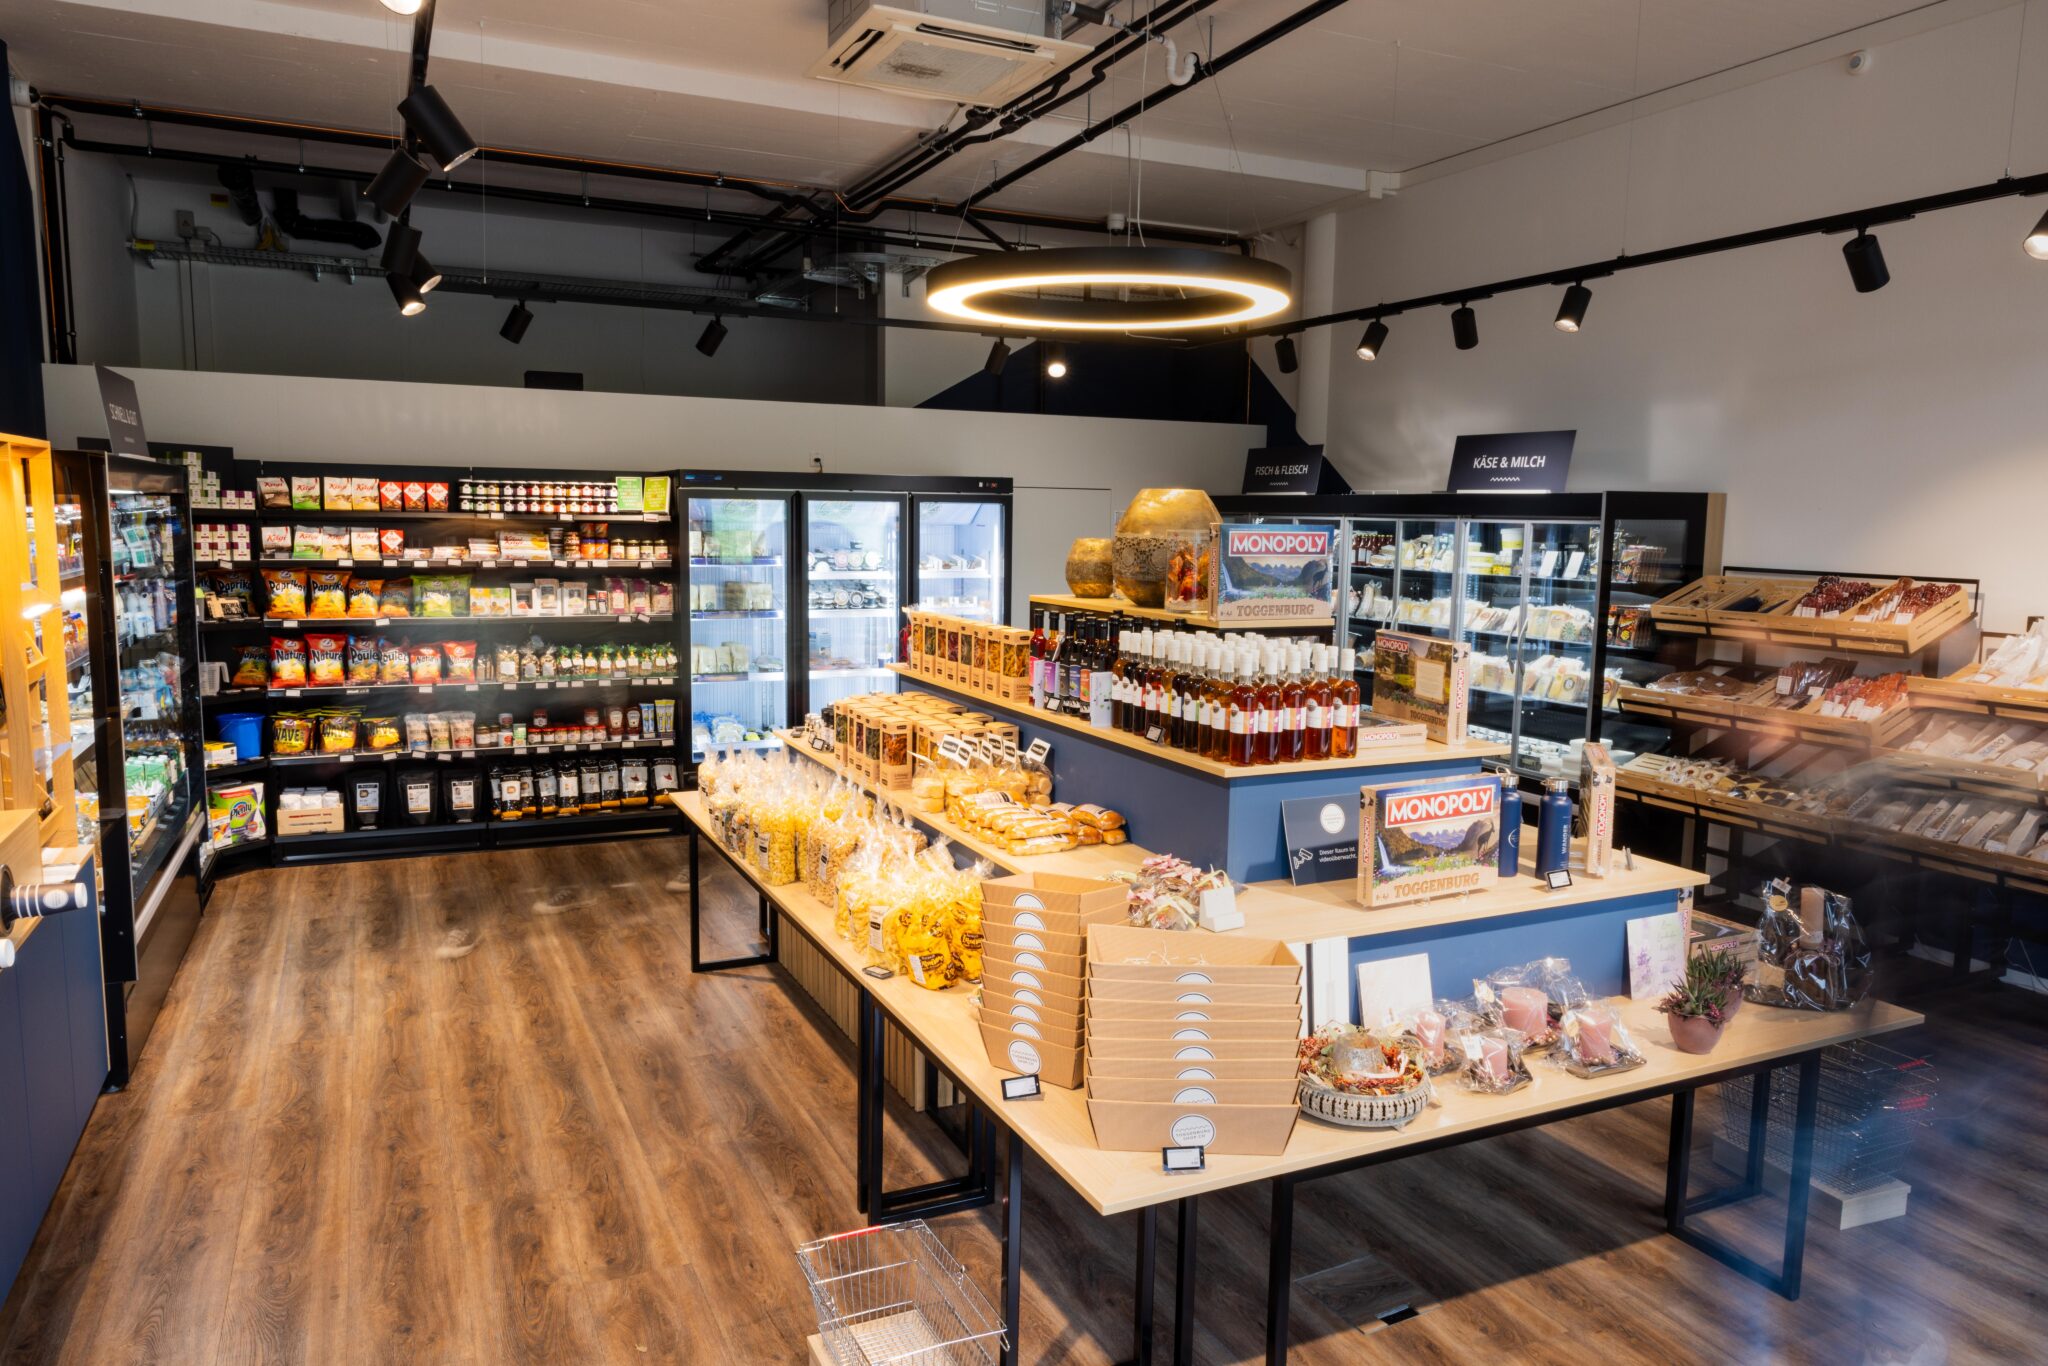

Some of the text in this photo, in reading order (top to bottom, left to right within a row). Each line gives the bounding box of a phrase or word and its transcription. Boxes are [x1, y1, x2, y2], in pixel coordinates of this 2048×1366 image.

[1255, 464, 1309, 475] FISCH & FLEISCH
[1473, 455, 1546, 469] KÄSE & MILCH
[1232, 535, 1325, 553] MONOPOLY
[1237, 604, 1315, 617] TOGGENBURG
[1377, 637, 1409, 653] MONOPOLY
[275, 649, 306, 663] Nature
[310, 649, 343, 663] Nature
[1363, 732, 1398, 741] MONOPOLY
[230, 804, 252, 820] Plenty
[1390, 789, 1491, 822] MONOPOLY
[1597, 794, 1608, 836] MONOPOLY
[1363, 816, 1371, 864] MONOPOLY
[1561, 824, 1569, 854] WANDER
[1394, 872, 1479, 898] TOGGENBURG
[1711, 941, 1737, 952] MONOPOLY
